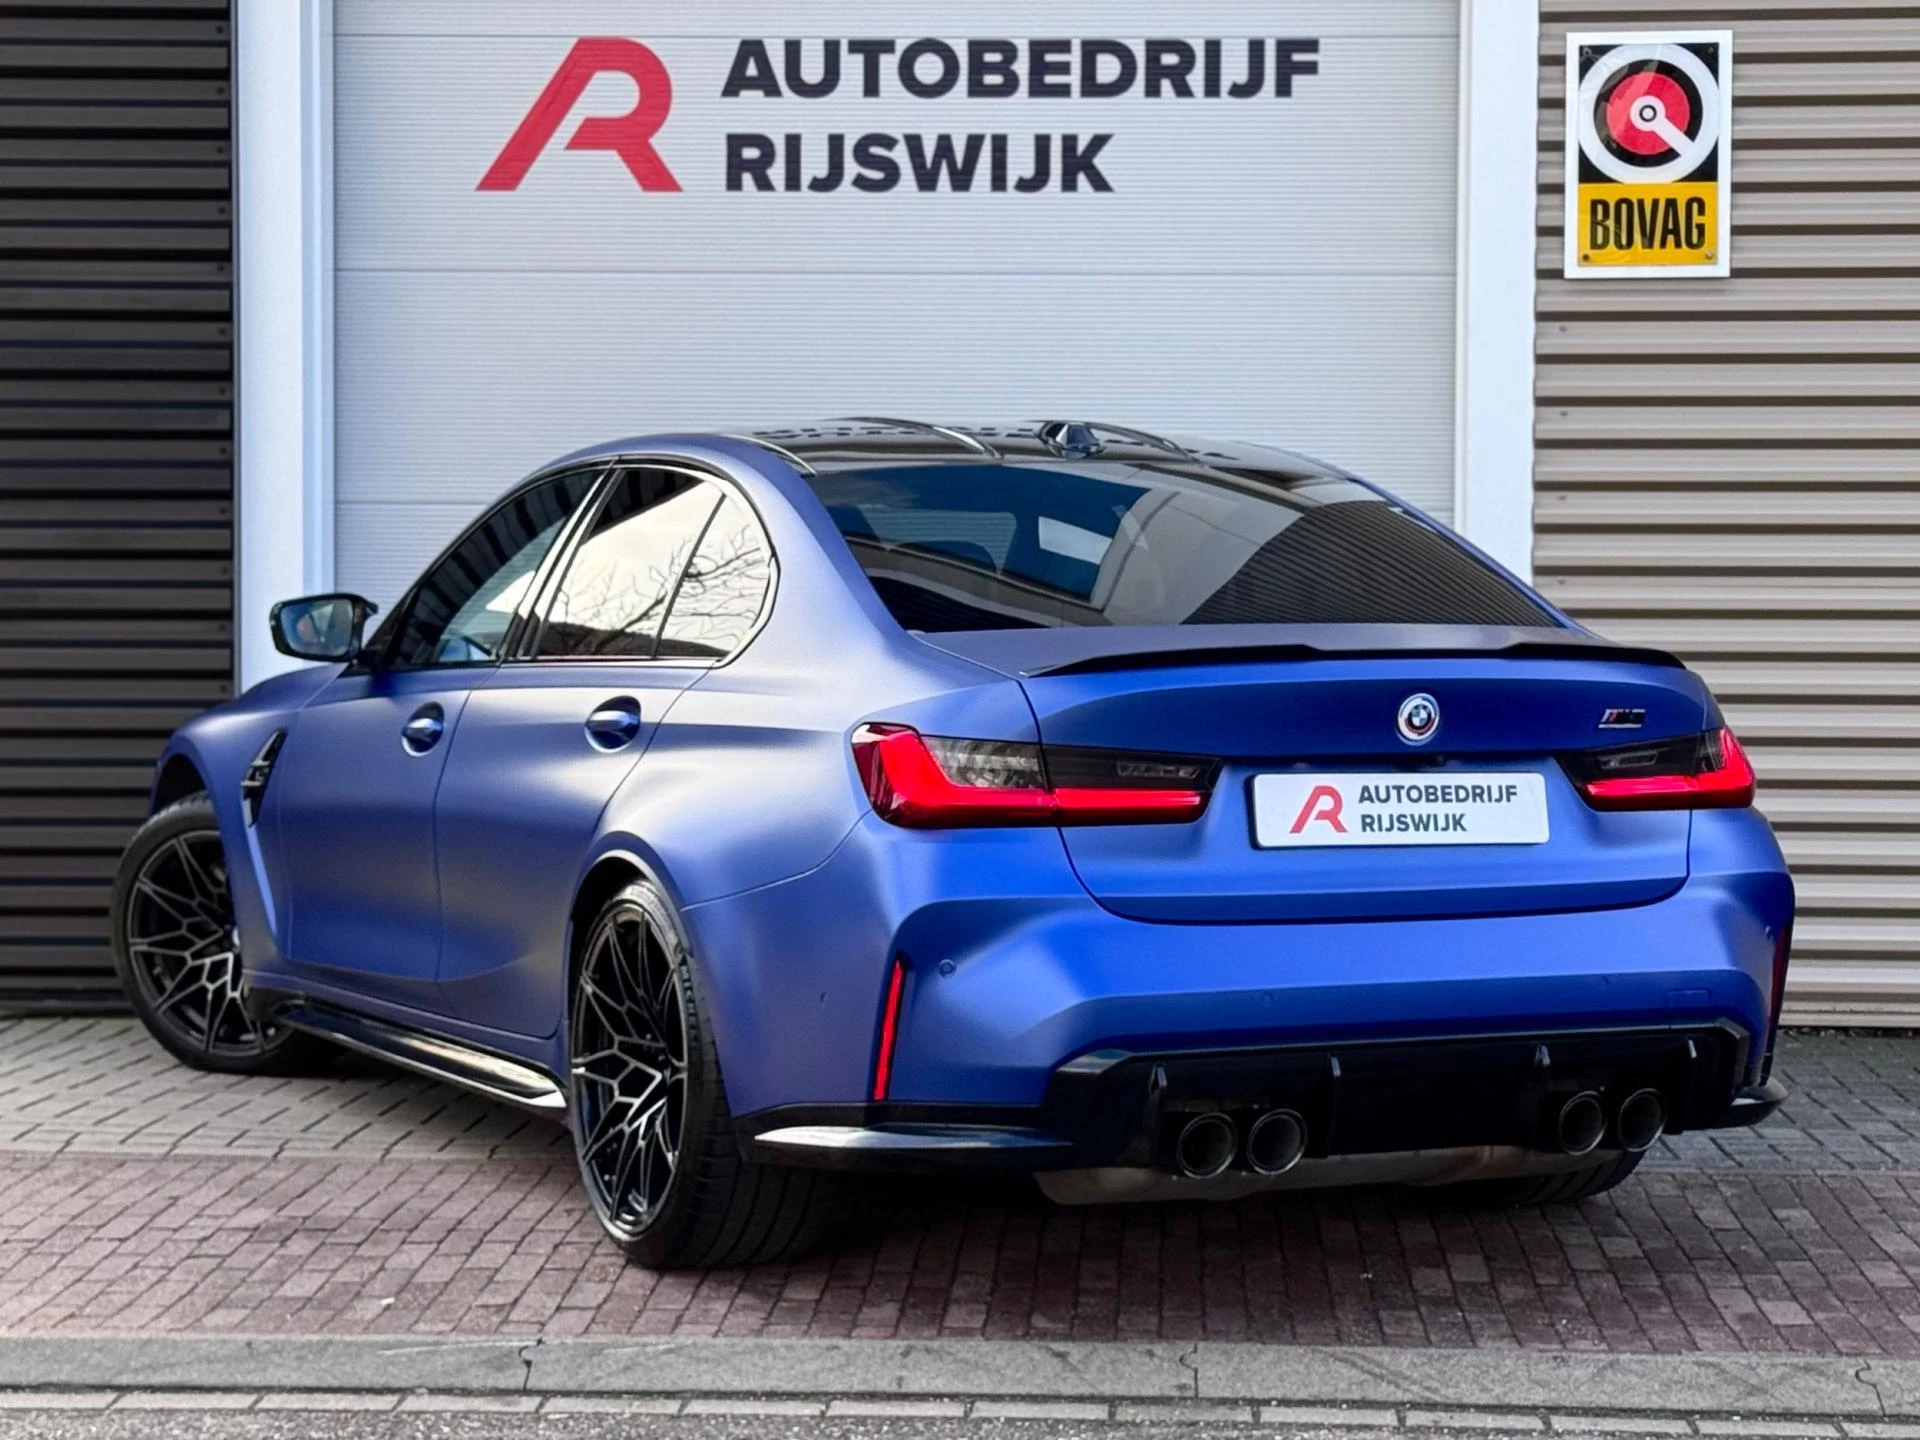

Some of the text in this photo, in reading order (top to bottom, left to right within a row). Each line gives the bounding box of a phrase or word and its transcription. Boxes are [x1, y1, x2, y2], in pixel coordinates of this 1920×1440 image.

[721, 37, 1320, 98] AUTOBEDRIJF
[726, 133, 1114, 193] RIJSWIJK
[1590, 196, 1706, 250] BOVAG
[1358, 784, 1518, 804] AUTOBEDRIJF
[1360, 813, 1467, 833] RIJSWIJK
